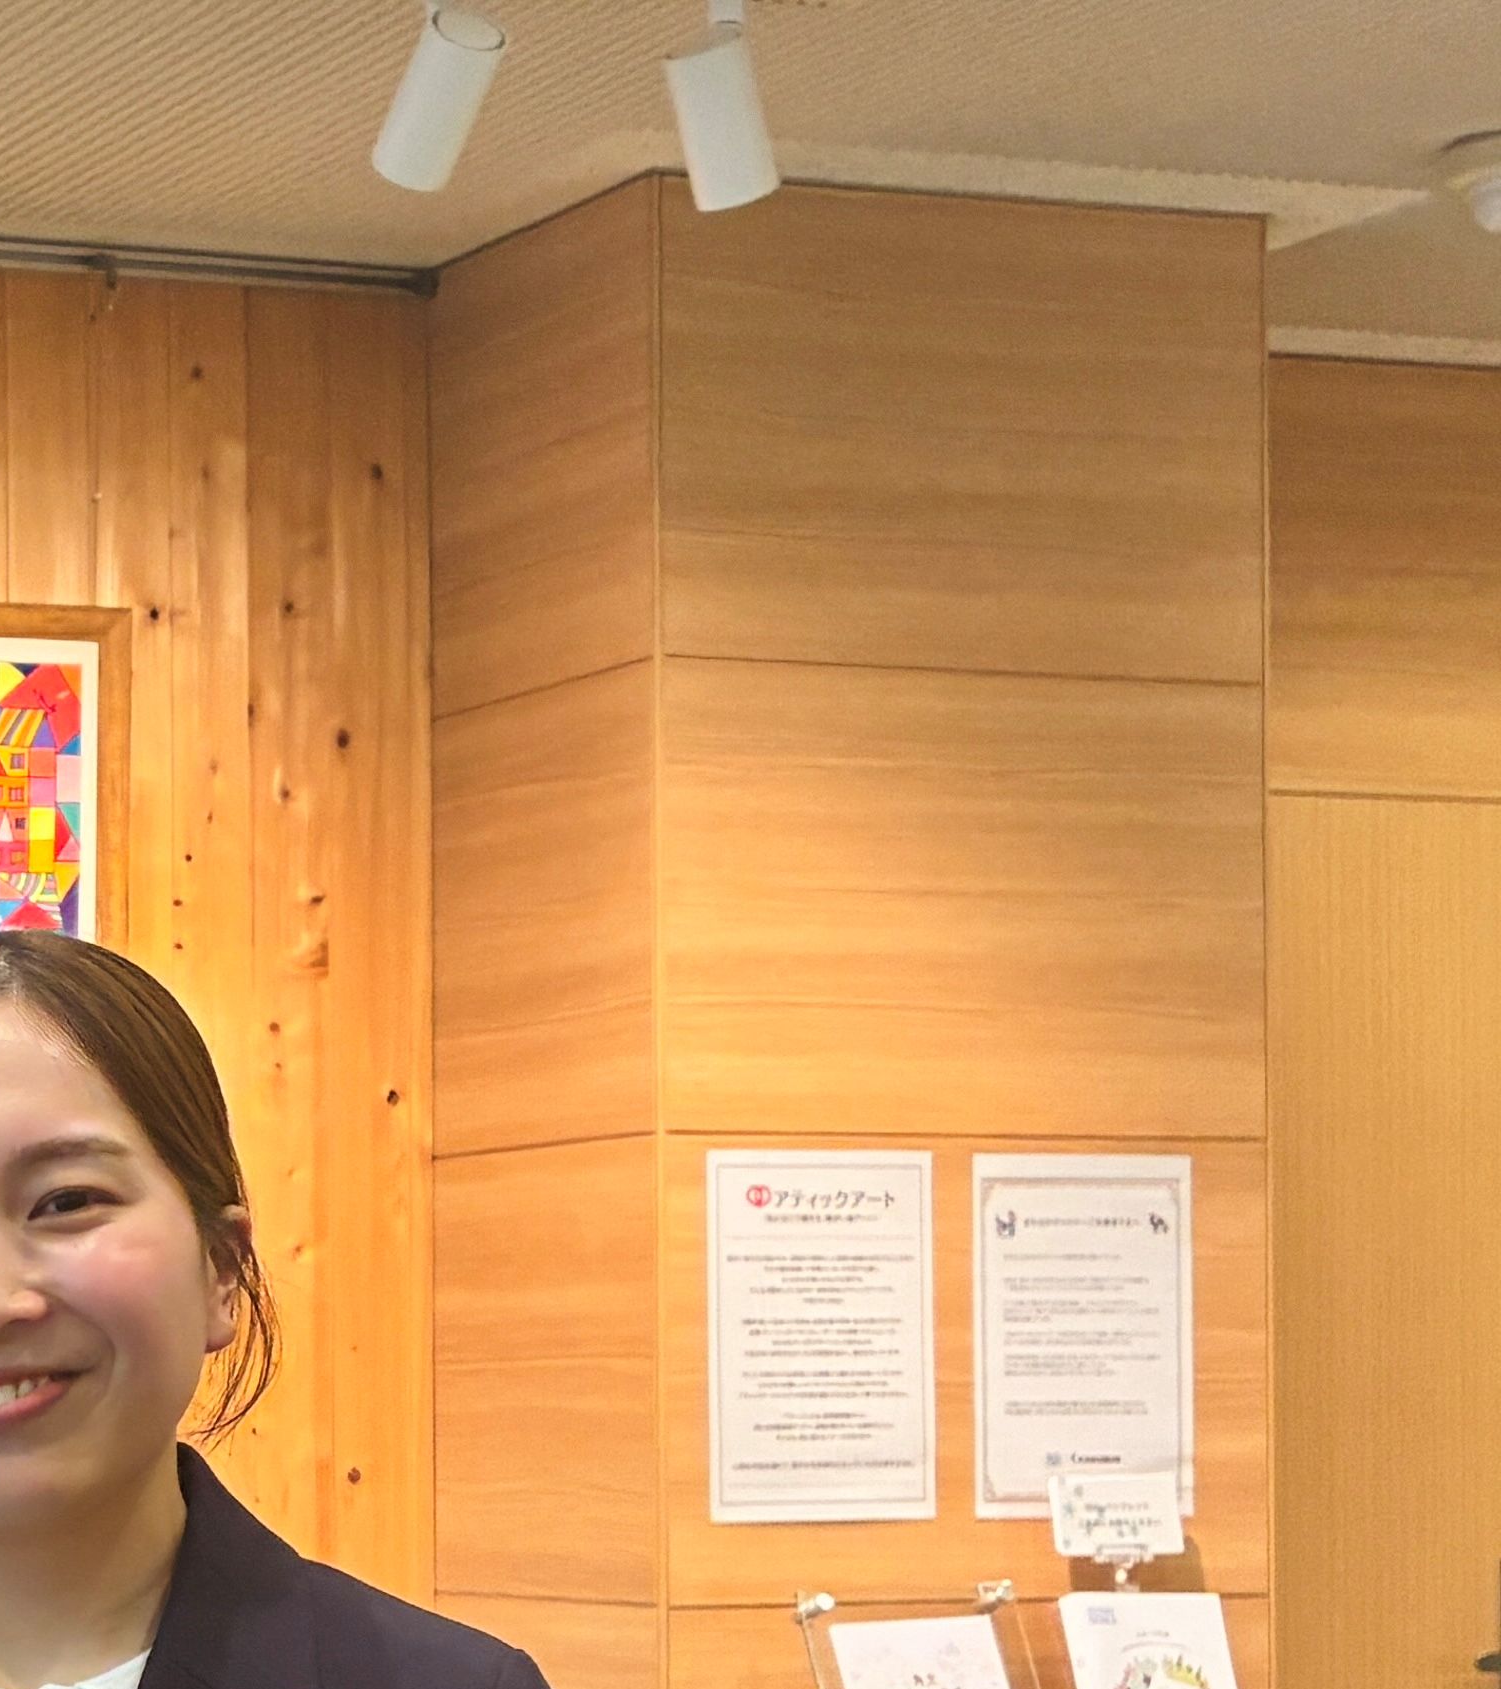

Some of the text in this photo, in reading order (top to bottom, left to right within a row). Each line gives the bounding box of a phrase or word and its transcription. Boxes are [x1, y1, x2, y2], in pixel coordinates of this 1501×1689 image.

[774, 1188, 895, 1209] アティックアート
